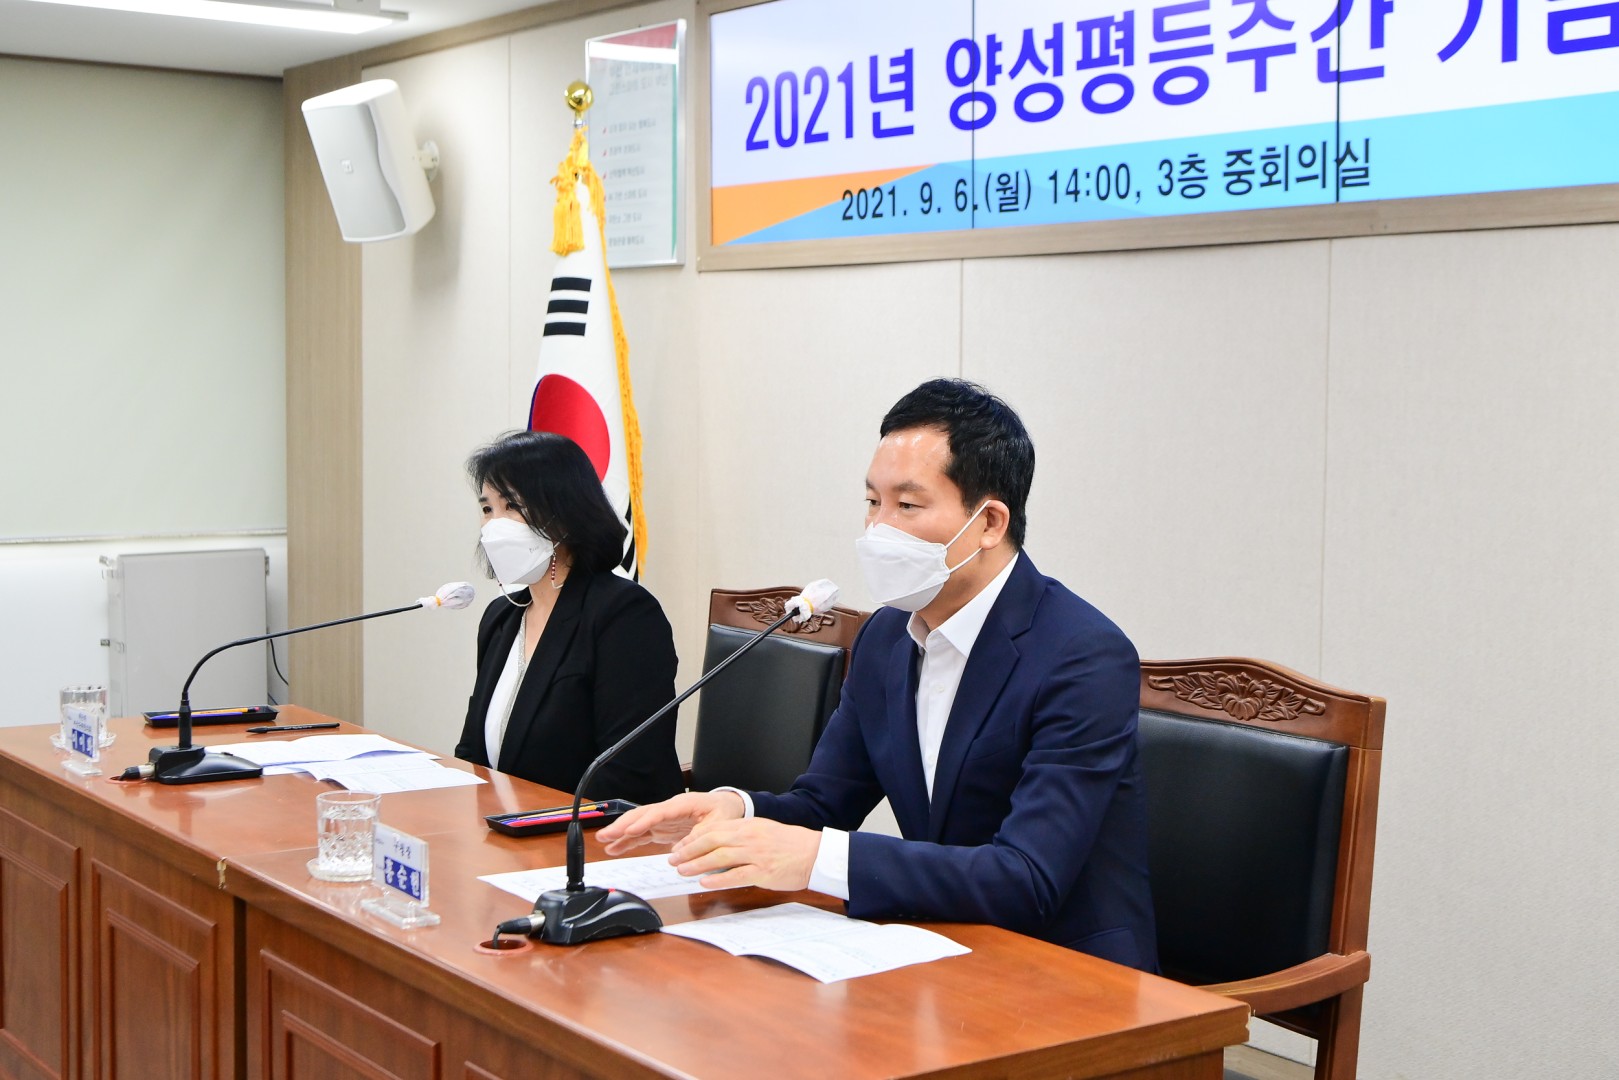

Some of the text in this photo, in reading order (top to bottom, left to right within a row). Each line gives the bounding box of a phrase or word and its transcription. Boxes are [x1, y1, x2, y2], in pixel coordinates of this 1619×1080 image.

[745, 48, 914, 151] 2021년
[945, 0, 1394, 131] 양성평등주간
[842, 138, 1371, 221] 2021. 9. 6.(월) 14:00, 3층 중회의실
